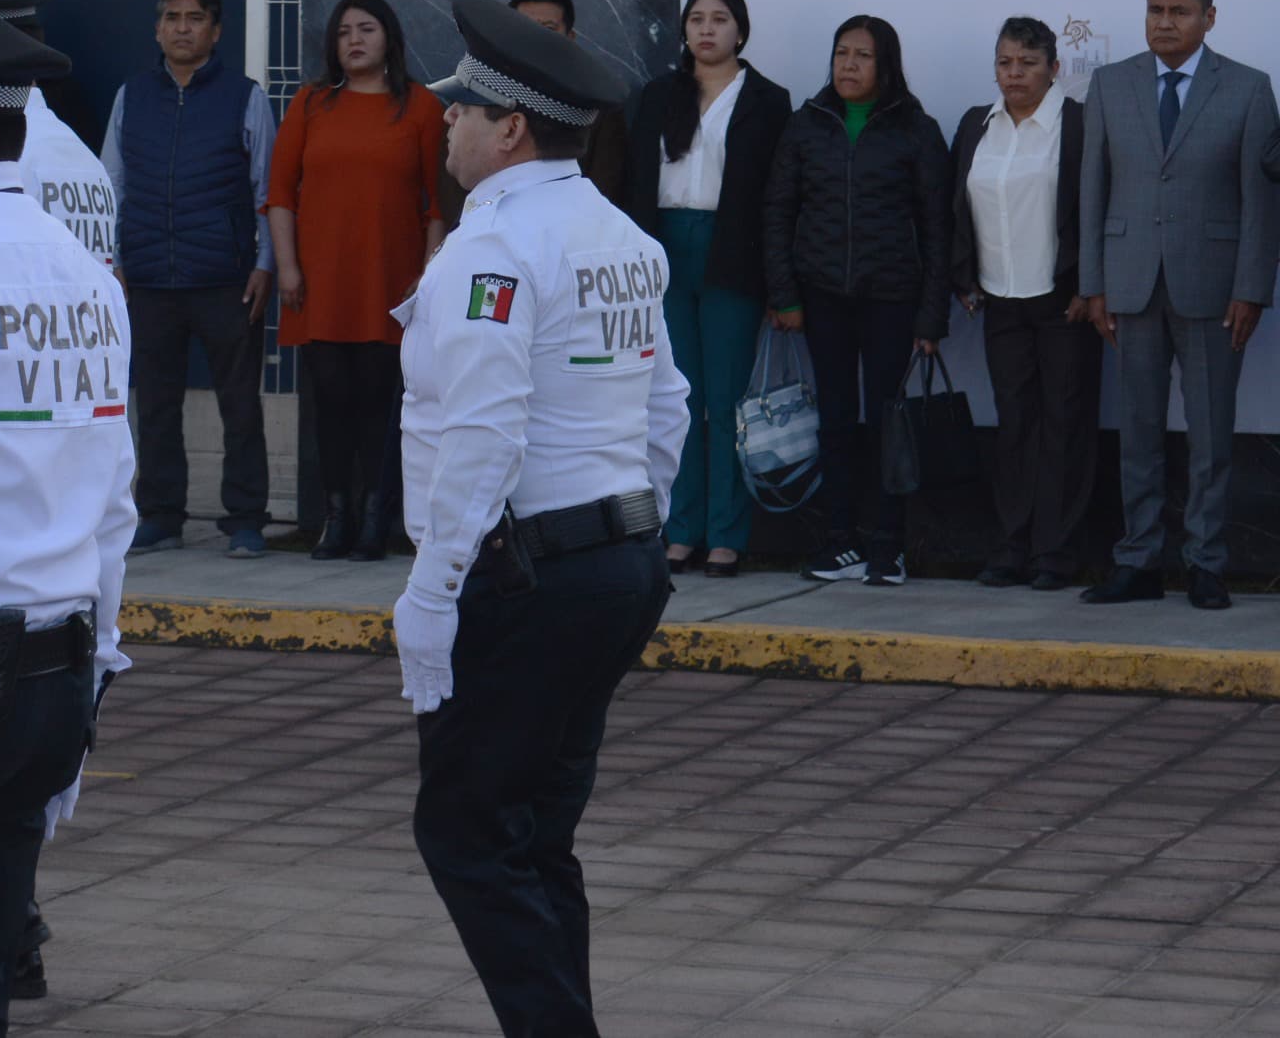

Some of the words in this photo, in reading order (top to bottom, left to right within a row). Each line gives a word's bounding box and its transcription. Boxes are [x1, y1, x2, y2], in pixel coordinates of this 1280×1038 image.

[475, 275, 513, 290] MÉXICO
[575, 250, 664, 309] POLICÍA
[600, 305, 655, 352] VIAL
[16, 356, 119, 404] VIAL
